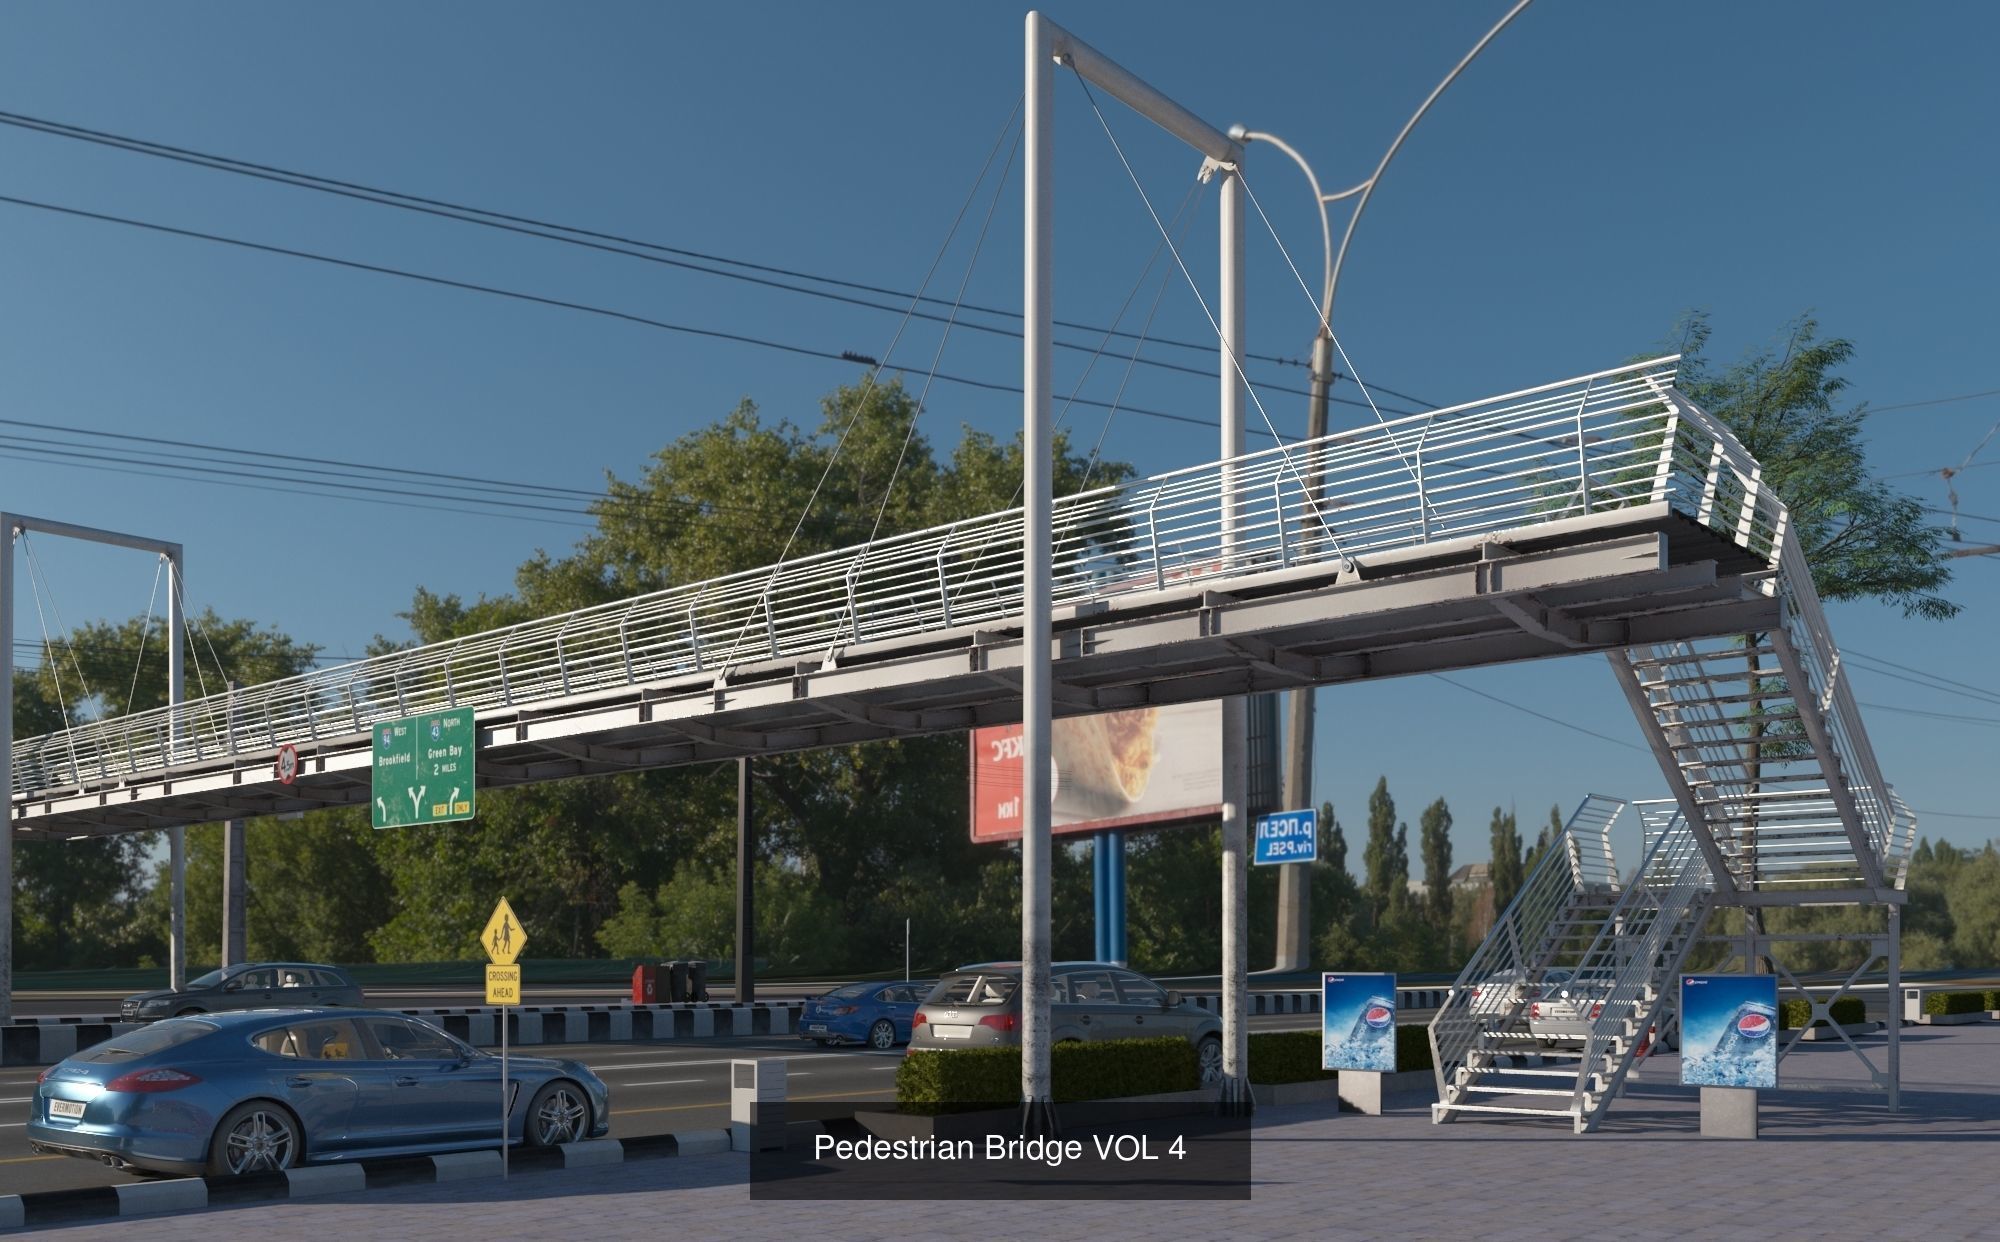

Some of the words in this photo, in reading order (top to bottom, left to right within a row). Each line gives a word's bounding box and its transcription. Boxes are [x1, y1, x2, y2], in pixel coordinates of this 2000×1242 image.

[394, 727, 407, 737] WEST
[431, 725, 440, 737] 43
[443, 718, 461, 728] NORTH
[428, 747, 447, 760] Green
[449, 745, 463, 758] Bay
[378, 752, 411, 767] Brookfield
[433, 763, 439, 776] 2
[441, 763, 457, 773] MILES
[488, 970, 518, 982] CROSSING
[492, 987, 514, 998] AHEAD
[53, 1101, 83, 1115] EVERMOTION
